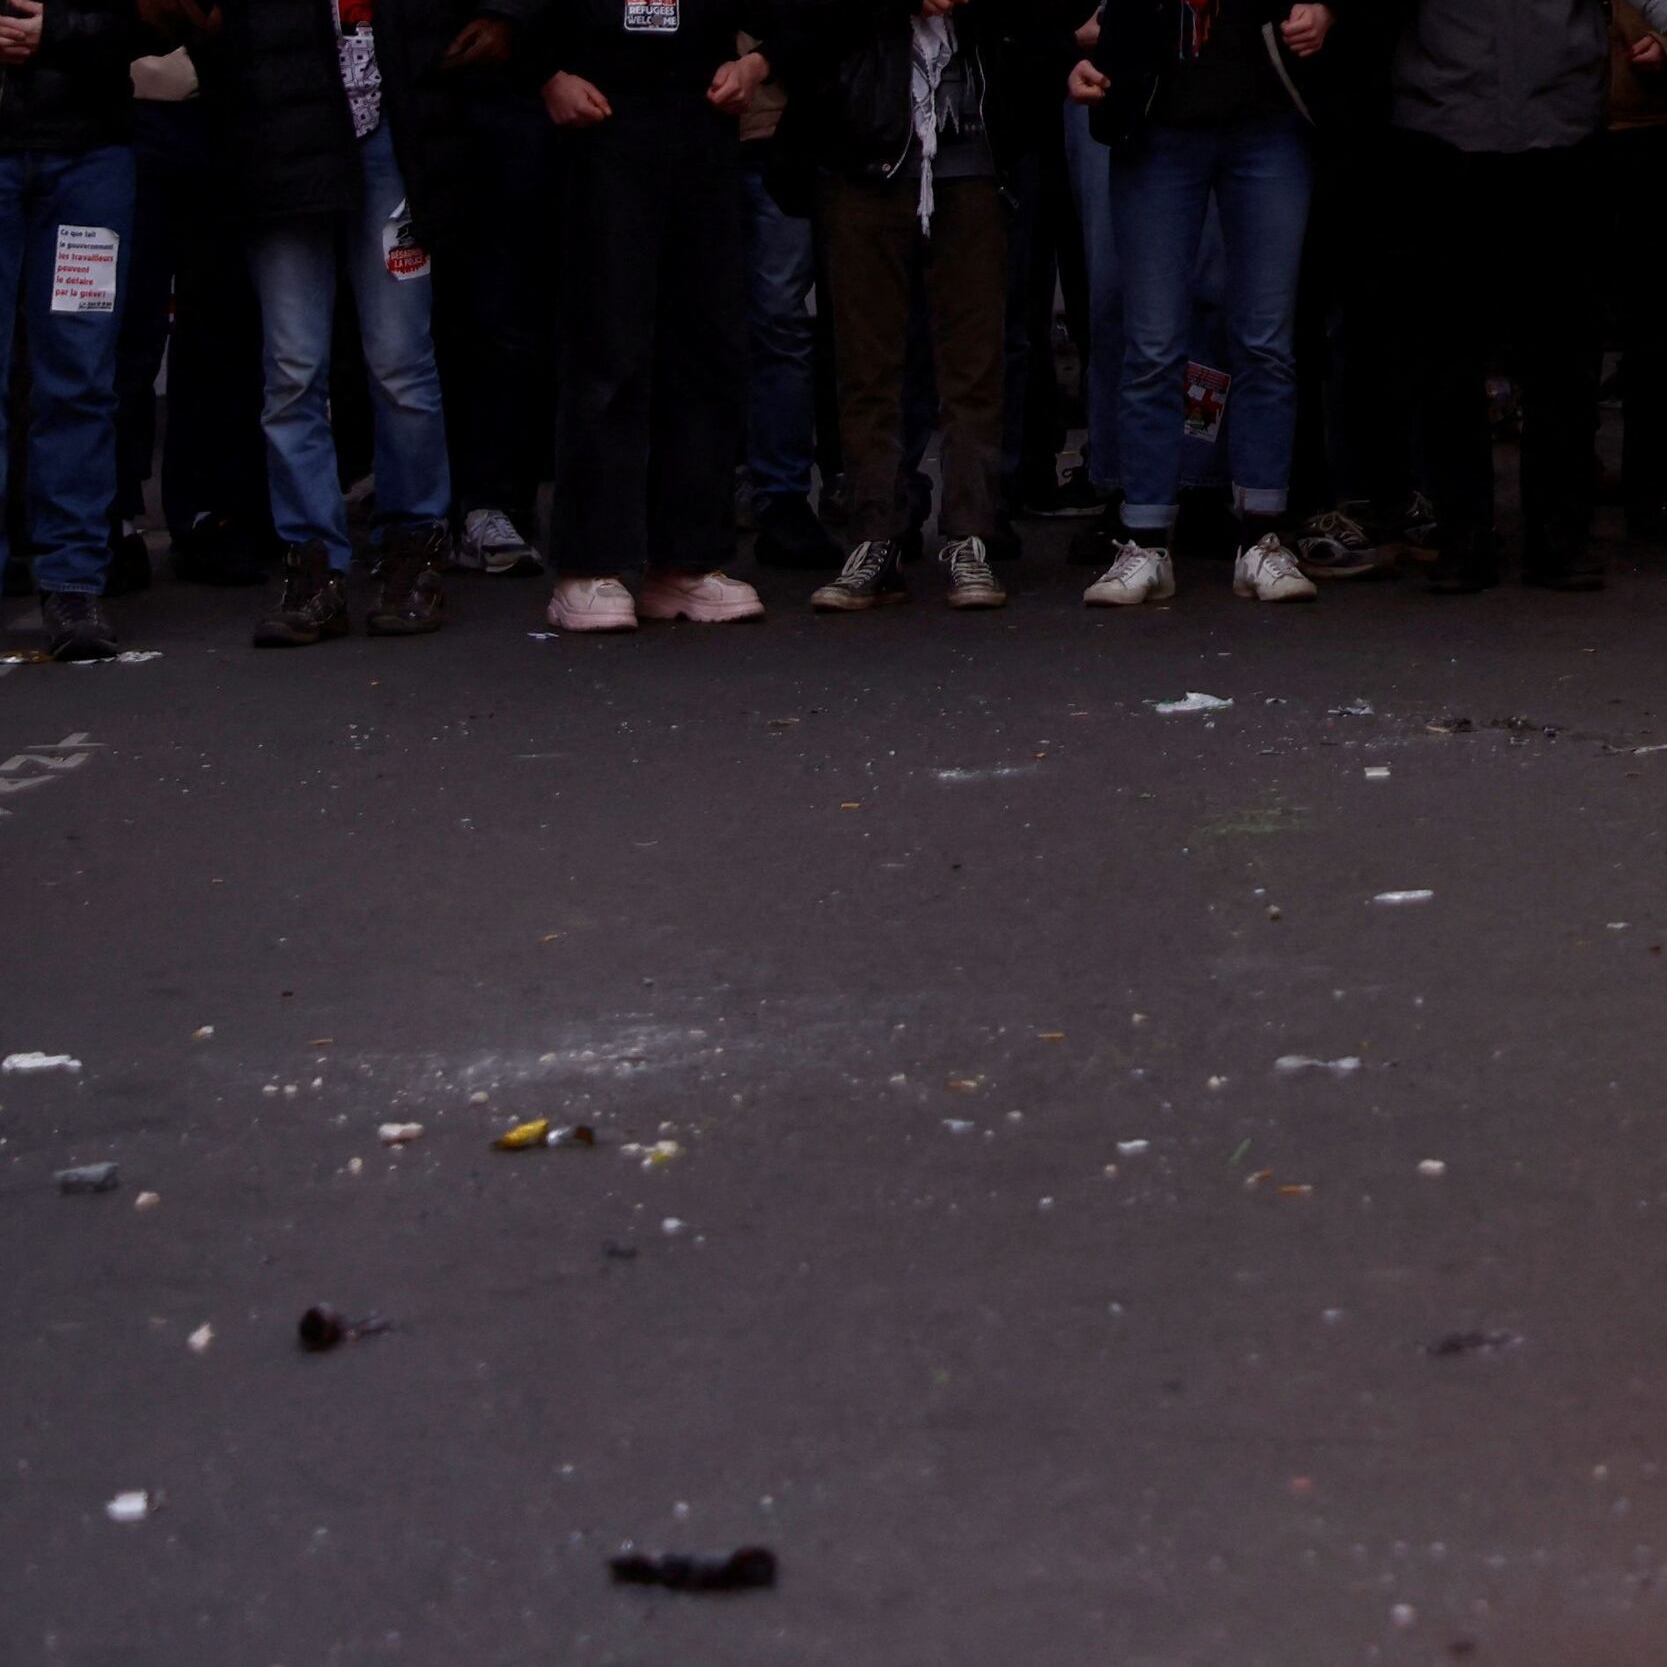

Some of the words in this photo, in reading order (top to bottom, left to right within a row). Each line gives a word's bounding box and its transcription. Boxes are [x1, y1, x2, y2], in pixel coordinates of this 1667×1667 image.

[629, 6, 675, 16] REFUGEES
[627, 15, 677, 26] WELCME
[71, 254, 113, 262] travailleurs
[57, 265, 90, 273] peuvent
[55, 289, 69, 297] par
